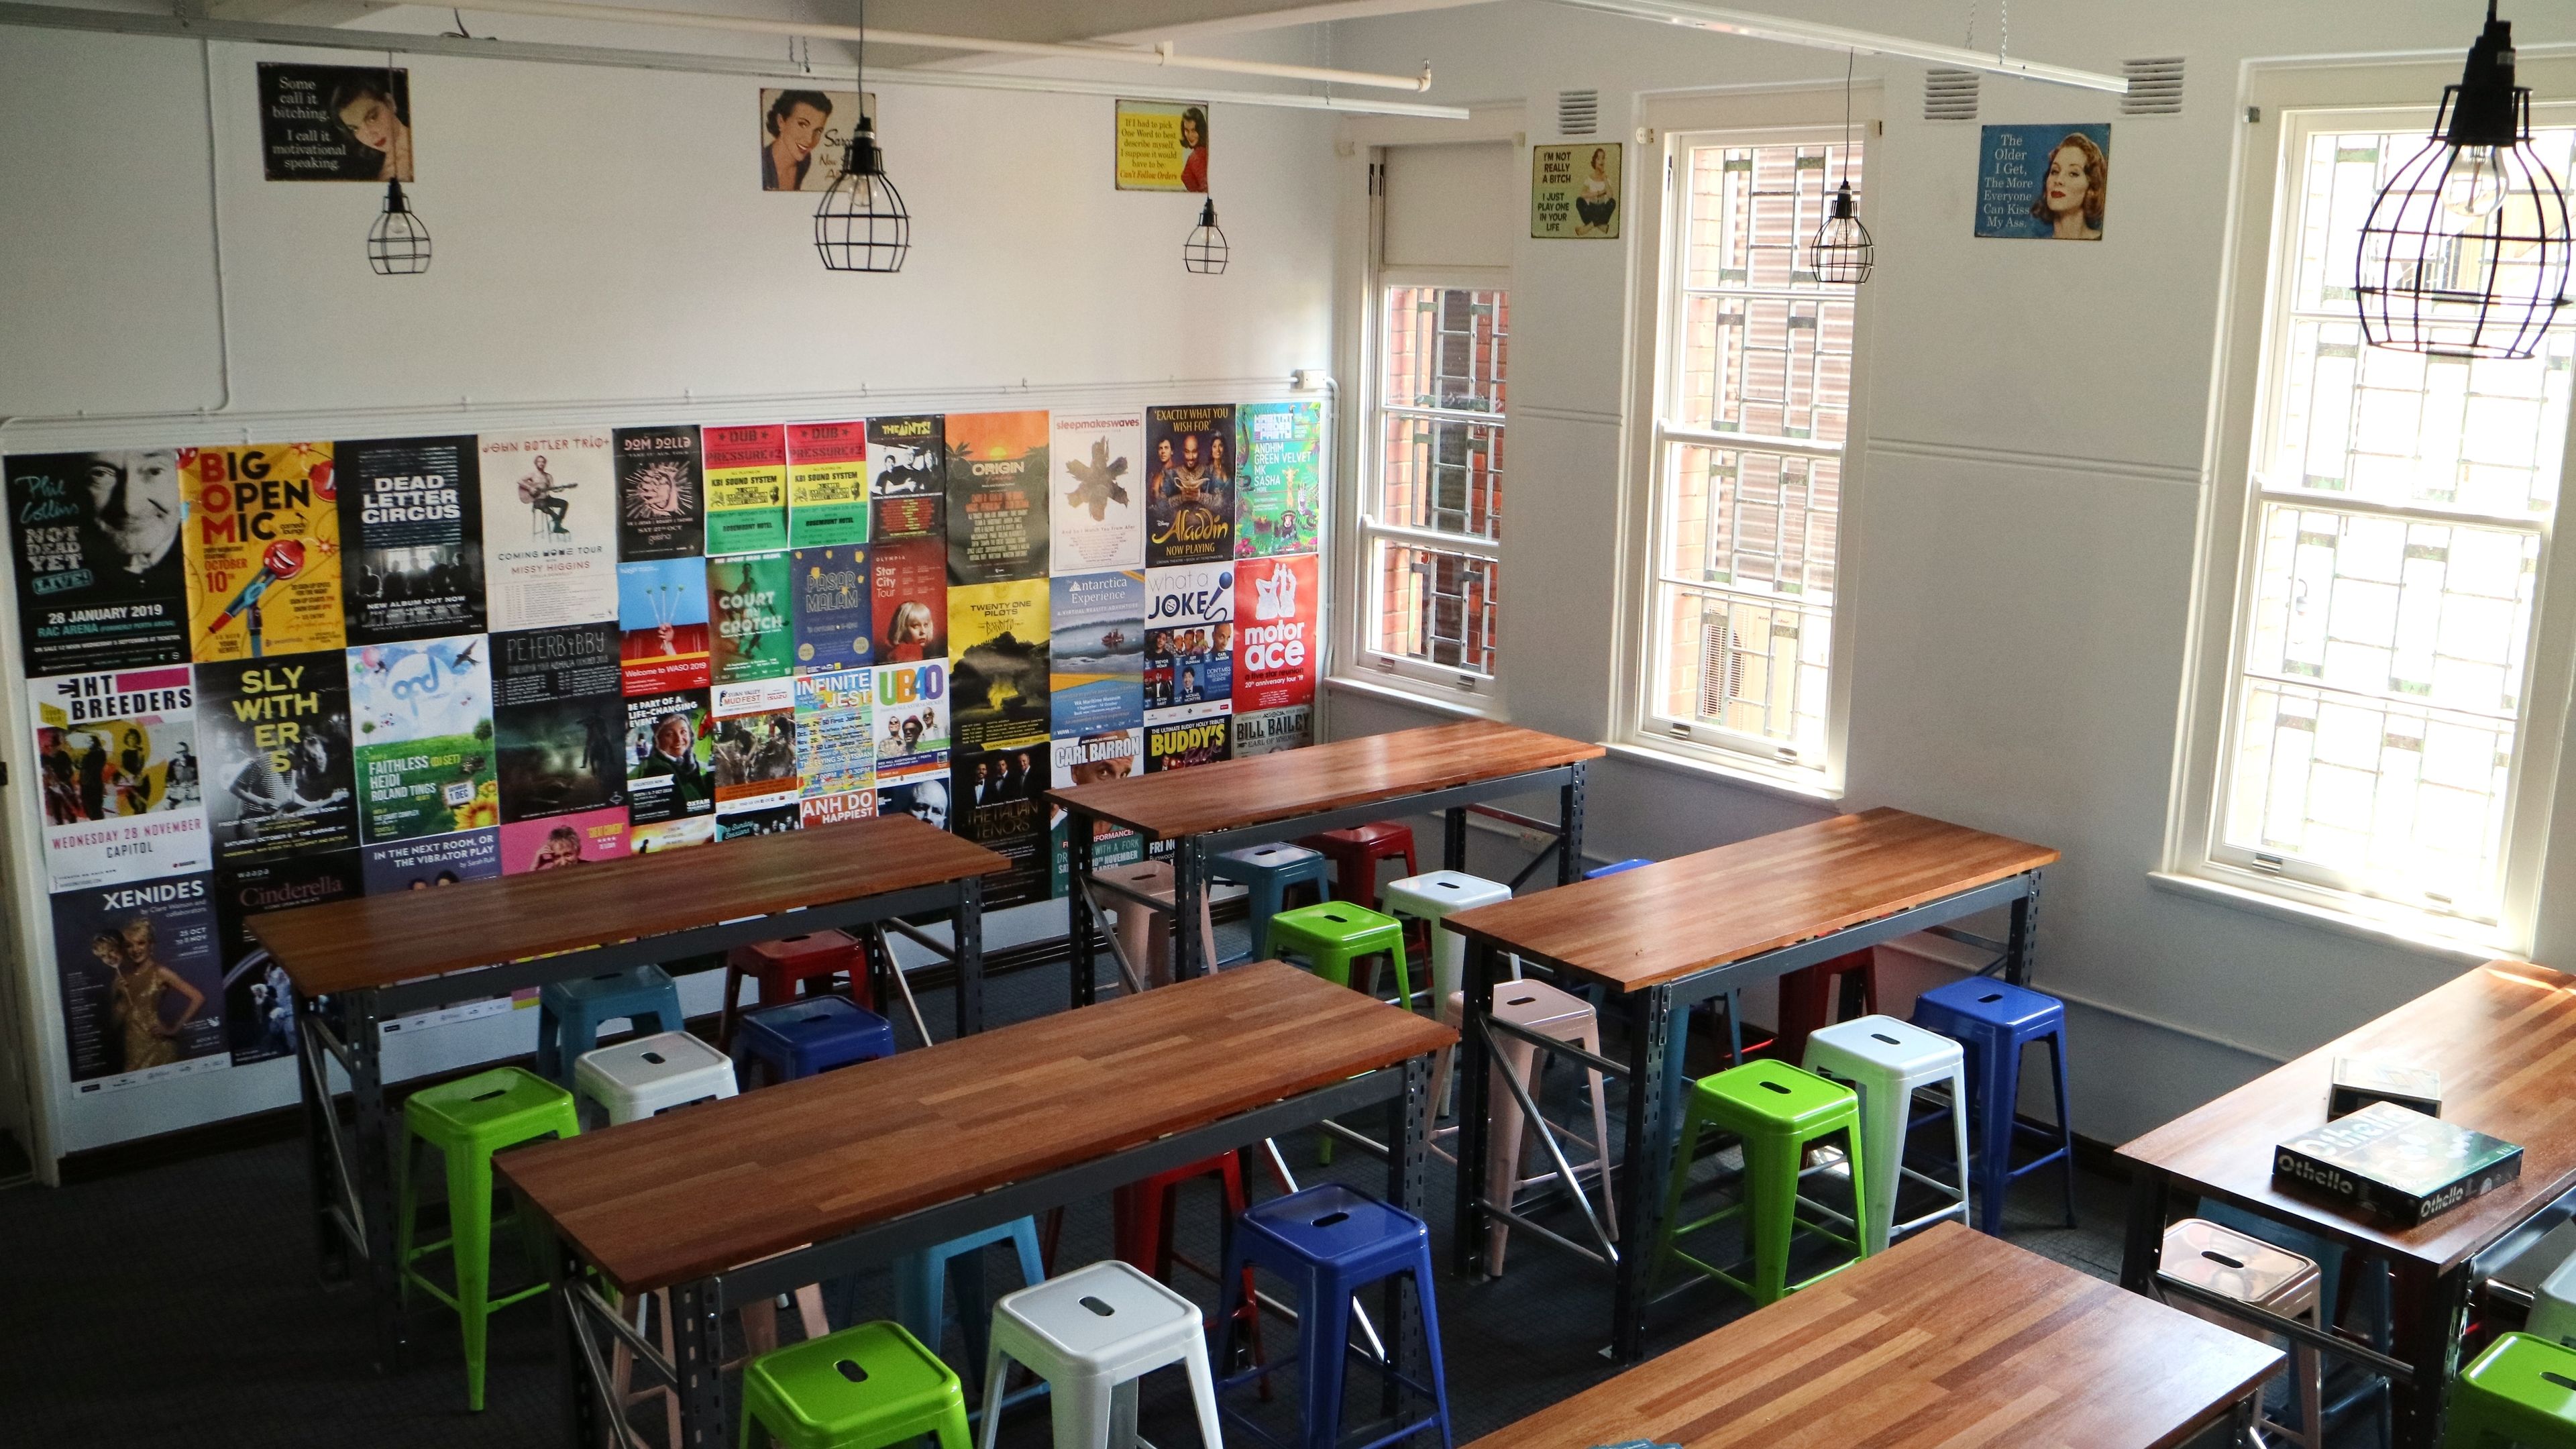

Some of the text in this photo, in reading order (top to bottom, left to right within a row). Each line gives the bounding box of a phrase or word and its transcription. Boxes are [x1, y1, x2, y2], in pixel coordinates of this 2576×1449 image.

[279, 76, 316, 91] Some
[279, 93, 317, 105] call it
[272, 106, 331, 122] bitching.
[1126, 119, 1131, 127] If
[1137, 119, 1149, 128] had
[1159, 121, 1173, 129] pick
[287, 129, 331, 142] I call it
[1122, 128, 1176, 140] One Word to best
[2000, 134, 2023, 146] The
[272, 144, 346, 155] motivational
[1121, 149, 1124, 157] I
[1125, 151, 1150, 159] suppose
[1544, 152, 1571, 162] I'M NOT
[1994, 148, 2027, 160] Older
[1132, 159, 1147, 167] have
[1544, 163, 1570, 172] REALLY
[1542, 174, 1571, 183] A BITCH
[1984, 177, 2033, 188] The More
[1547, 193, 1564, 201] JUST
[1984, 190, 2032, 203] Everyone
[1538, 203, 1570, 211] PLAY ONE
[1984, 204, 2030, 215] Can Kiss
[1540, 213, 1567, 221] IN YOUR
[1986, 216, 2027, 229] My Ass.
[1546, 223, 1560, 231] LIFE
[1190, 409, 1212, 420] WHAT
[1213, 408, 1228, 418] YOU
[1057, 418, 1140, 430] sleepmakeswaves
[729, 430, 757, 442] DUB
[811, 427, 839, 439] DUB
[1254, 442, 1284, 454] ANDHIM
[1254, 451, 1311, 465] GREEN VELVET
[200, 451, 270, 483] BIG
[972, 462, 1025, 476] ORIGIN
[1254, 464, 1267, 475] MK
[374, 474, 445, 492] DEAD
[1254, 475, 1281, 486] SASHA
[201, 479, 310, 513] OPEN
[363, 488, 459, 508] LETTER
[361, 503, 462, 524] CIRCUS
[201, 511, 277, 545] MIC
[1151, 508, 1229, 544] Aladdin
[24, 525, 80, 544] NOT
[26, 541, 82, 557] DEAD
[498, 545, 603, 561] COMING HOME TOUR
[1166, 542, 1215, 556] NOW PLAYING
[26, 553, 84, 572] YET
[205, 558, 248, 571] OCTOBER
[875, 555, 906, 564] OLYMPIA
[511, 561, 590, 575] MISSY HIGGINS
[876, 566, 896, 576] Star
[807, 570, 856, 592] PASAR
[876, 577, 896, 588] City
[1148, 570, 1209, 592] what a
[389, 599, 421, 608] ALBUM
[424, 596, 442, 604] OUT
[445, 594, 466, 603] NOW
[719, 591, 775, 610] COURT
[806, 589, 858, 613] MALAM
[876, 588, 896, 598] Tour
[1071, 590, 1126, 605] Experience
[970, 602, 1010, 612] TWENTY
[1148, 590, 1209, 619] JOKE
[47, 604, 163, 625] 28 JANUARY 2019
[719, 615, 782, 634] CROTCH
[1244, 619, 1305, 645] motor
[1244, 639, 1305, 672] ace
[625, 669, 657, 678] Welcome
[666, 664, 688, 673] WASO
[690, 661, 707, 670] 2019
[241, 665, 305, 694] SLY
[796, 672, 871, 696] INFINITE
[879, 664, 944, 706] UB40
[71, 688, 193, 720] BREEDERS
[627, 696, 683, 712] BE PART OF A
[826, 688, 871, 708] JEST
[232, 691, 319, 722] WITH
[628, 701, 698, 720] LIFE-CHANGING
[629, 718, 660, 729] EVENT.
[1236, 712, 1310, 742] BILL BAILEY
[254, 721, 301, 748] ER
[1151, 723, 1226, 757] BUDDY'S
[271, 749, 291, 772] S
[813, 756, 837, 765] FLYING
[837, 751, 872, 762] SCOTSMAN
[1055, 737, 1140, 768] CARL BARRON
[370, 773, 400, 790] HEIDI
[371, 782, 437, 802] ROLAND TINGS
[686, 798, 710, 807] OXFAM
[802, 792, 872, 817] ANH DO
[822, 806, 873, 825] HAPPIEST
[52, 818, 201, 850] WEDNESDAY 28 NOVEMBER
[977, 817, 1030, 839] TENORS
[107, 841, 154, 859] CAPITOL
[374, 834, 494, 861] IN THE NEXT ROOM, OR
[1095, 838, 1139, 855] WITH A FORK
[1149, 841, 1163, 854] FRI
[393, 845, 495, 869] THE VIBRATOR PLAY
[237, 869, 270, 878] waapa
[102, 880, 205, 911] XENIDES
[239, 875, 343, 906] Cinderella
[2294, 1107, 2416, 1157] Othello
[2277, 1154, 2354, 1195] Othello
[2420, 1185, 2464, 1218] Othello
